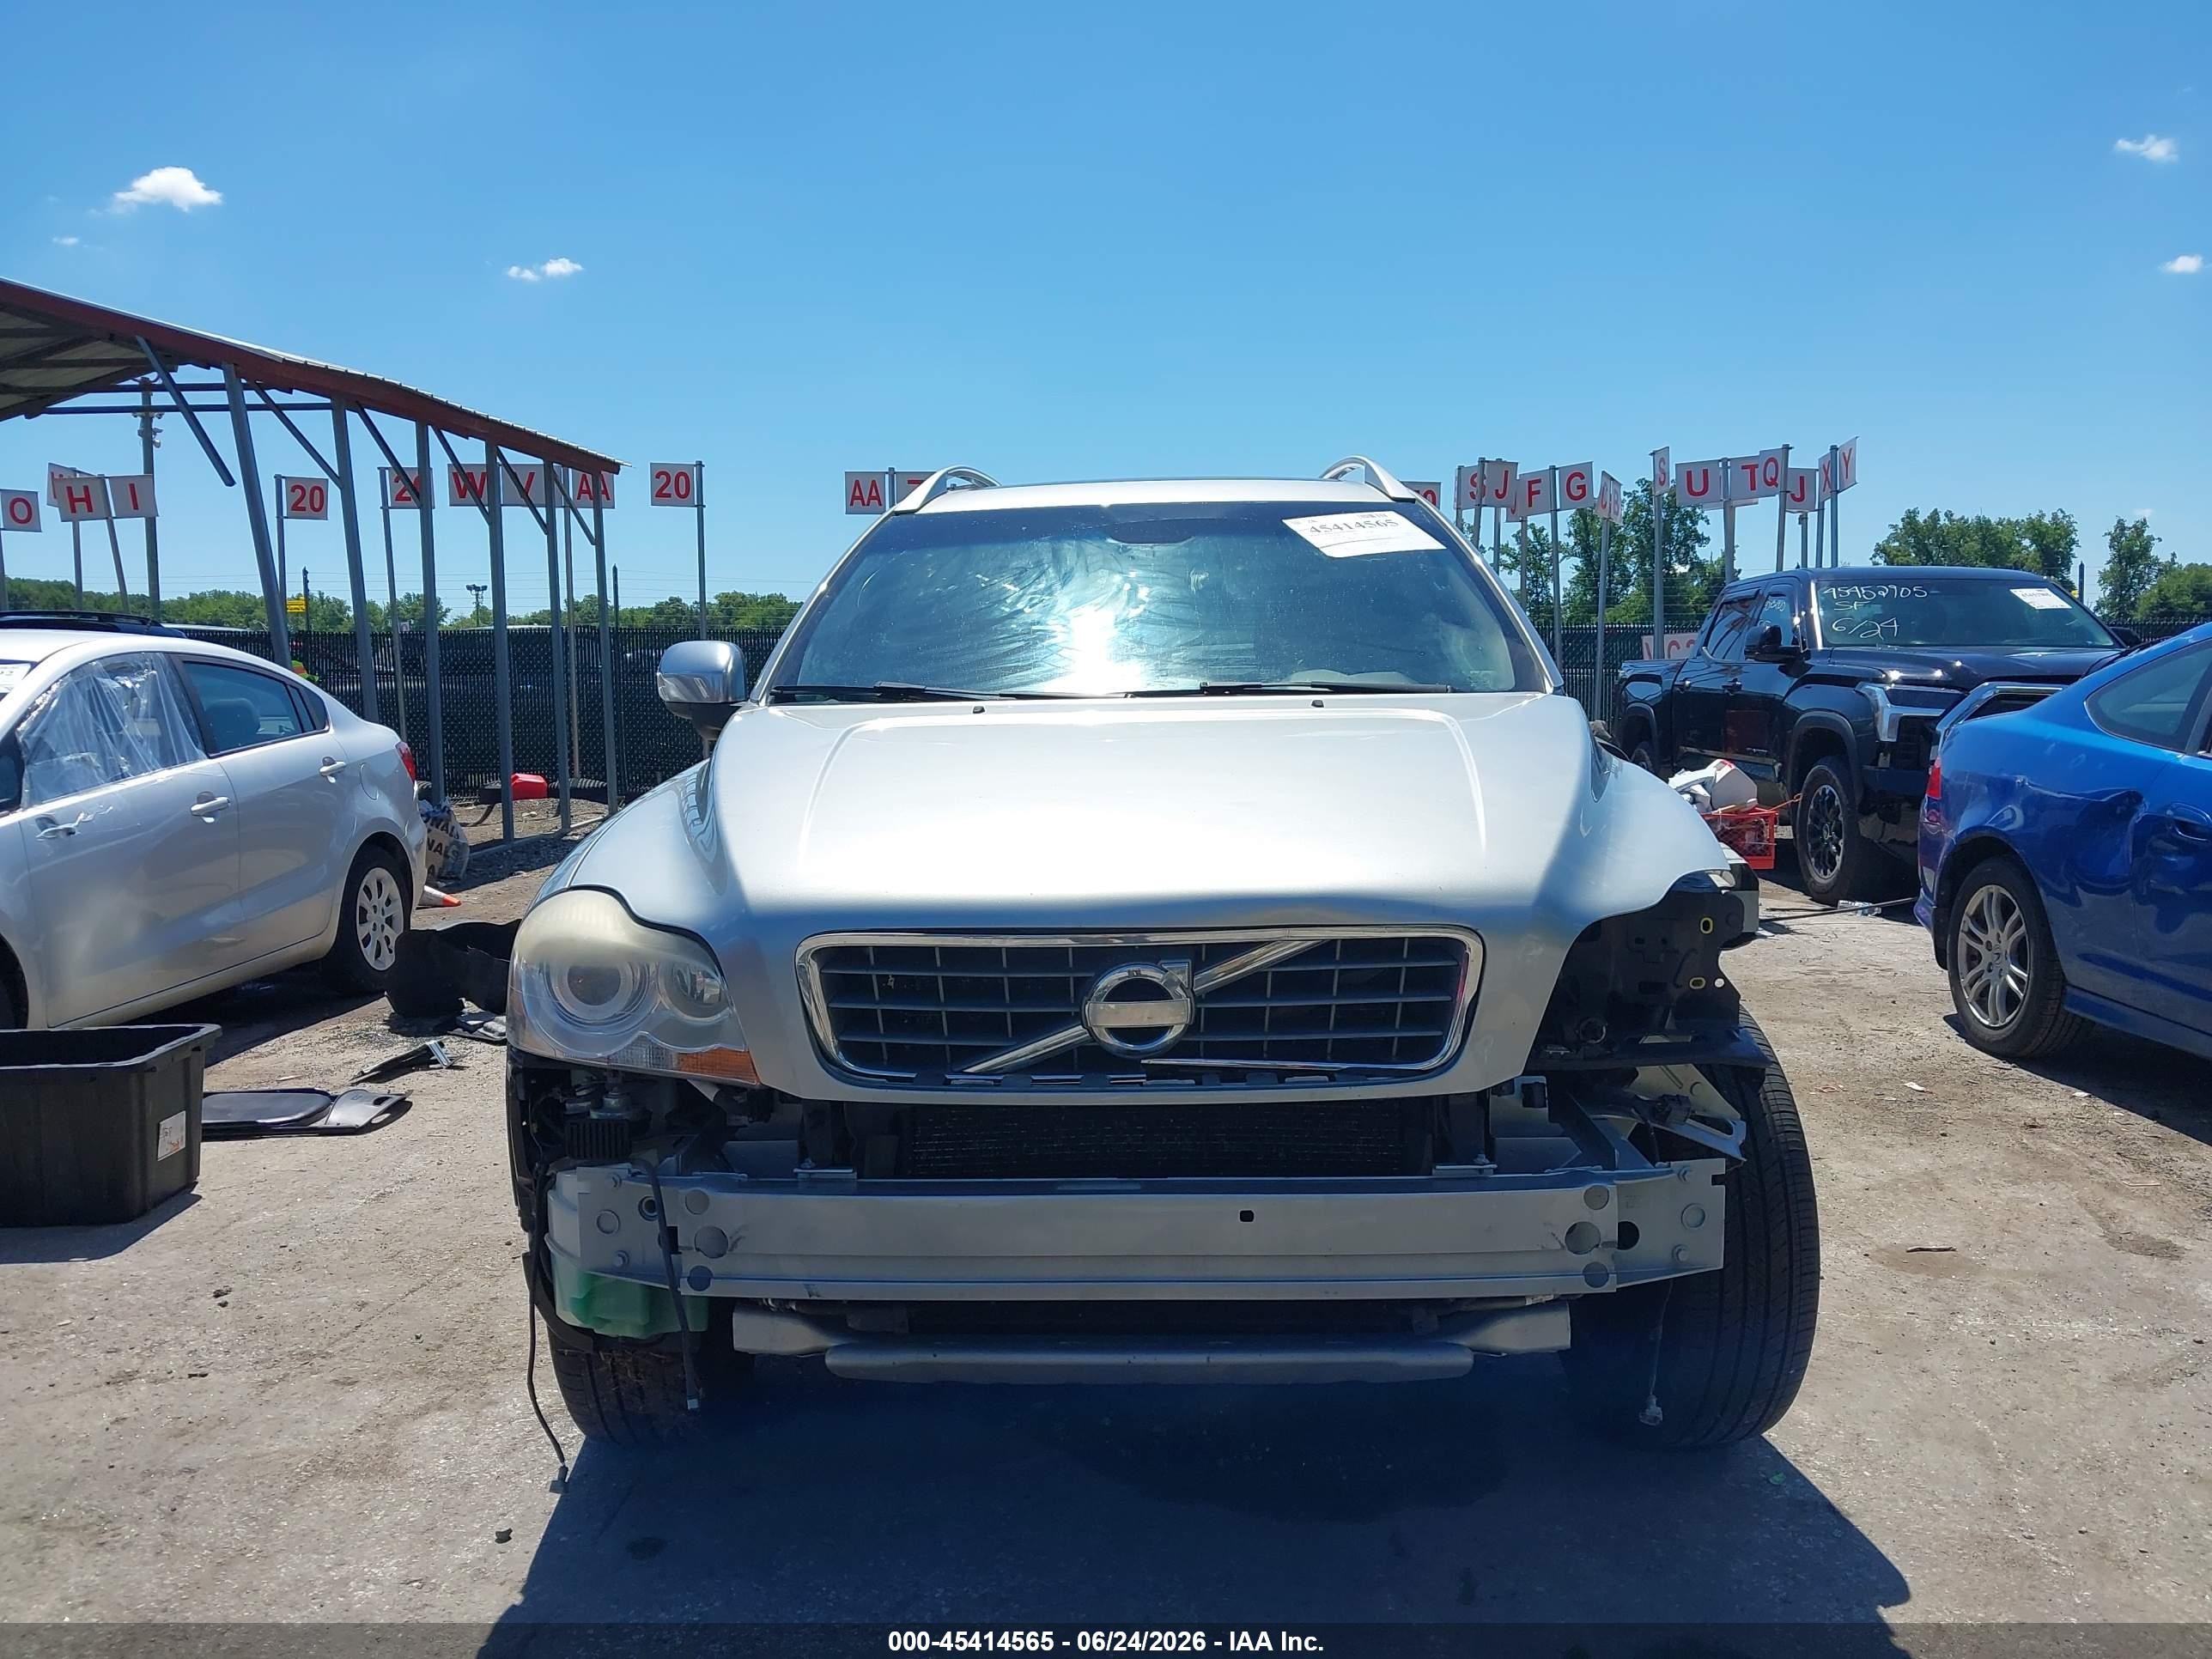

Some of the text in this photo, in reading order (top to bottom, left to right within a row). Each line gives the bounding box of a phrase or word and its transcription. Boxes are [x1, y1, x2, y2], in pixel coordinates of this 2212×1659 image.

[1658, 458, 1667, 487] S
[1741, 464, 1759, 491] T
[1762, 457, 1779, 488] Q
[1841, 447, 1854, 479] Y
[128, 483, 139, 511] I
[452, 471, 489, 499] W
[653, 471, 691, 499] 20
[849, 479, 883, 507] AA
[1494, 471, 1510, 500] J
[1527, 478, 1542, 508] F
[1565, 471, 1587, 501] G
[1686, 469, 1710, 497] U
[1790, 476, 1806, 503] J
[9, 496, 33, 525] O
[65, 484, 94, 514] H
[289, 484, 325, 513] 20
[1832, 617, 1900, 641] 6/24
